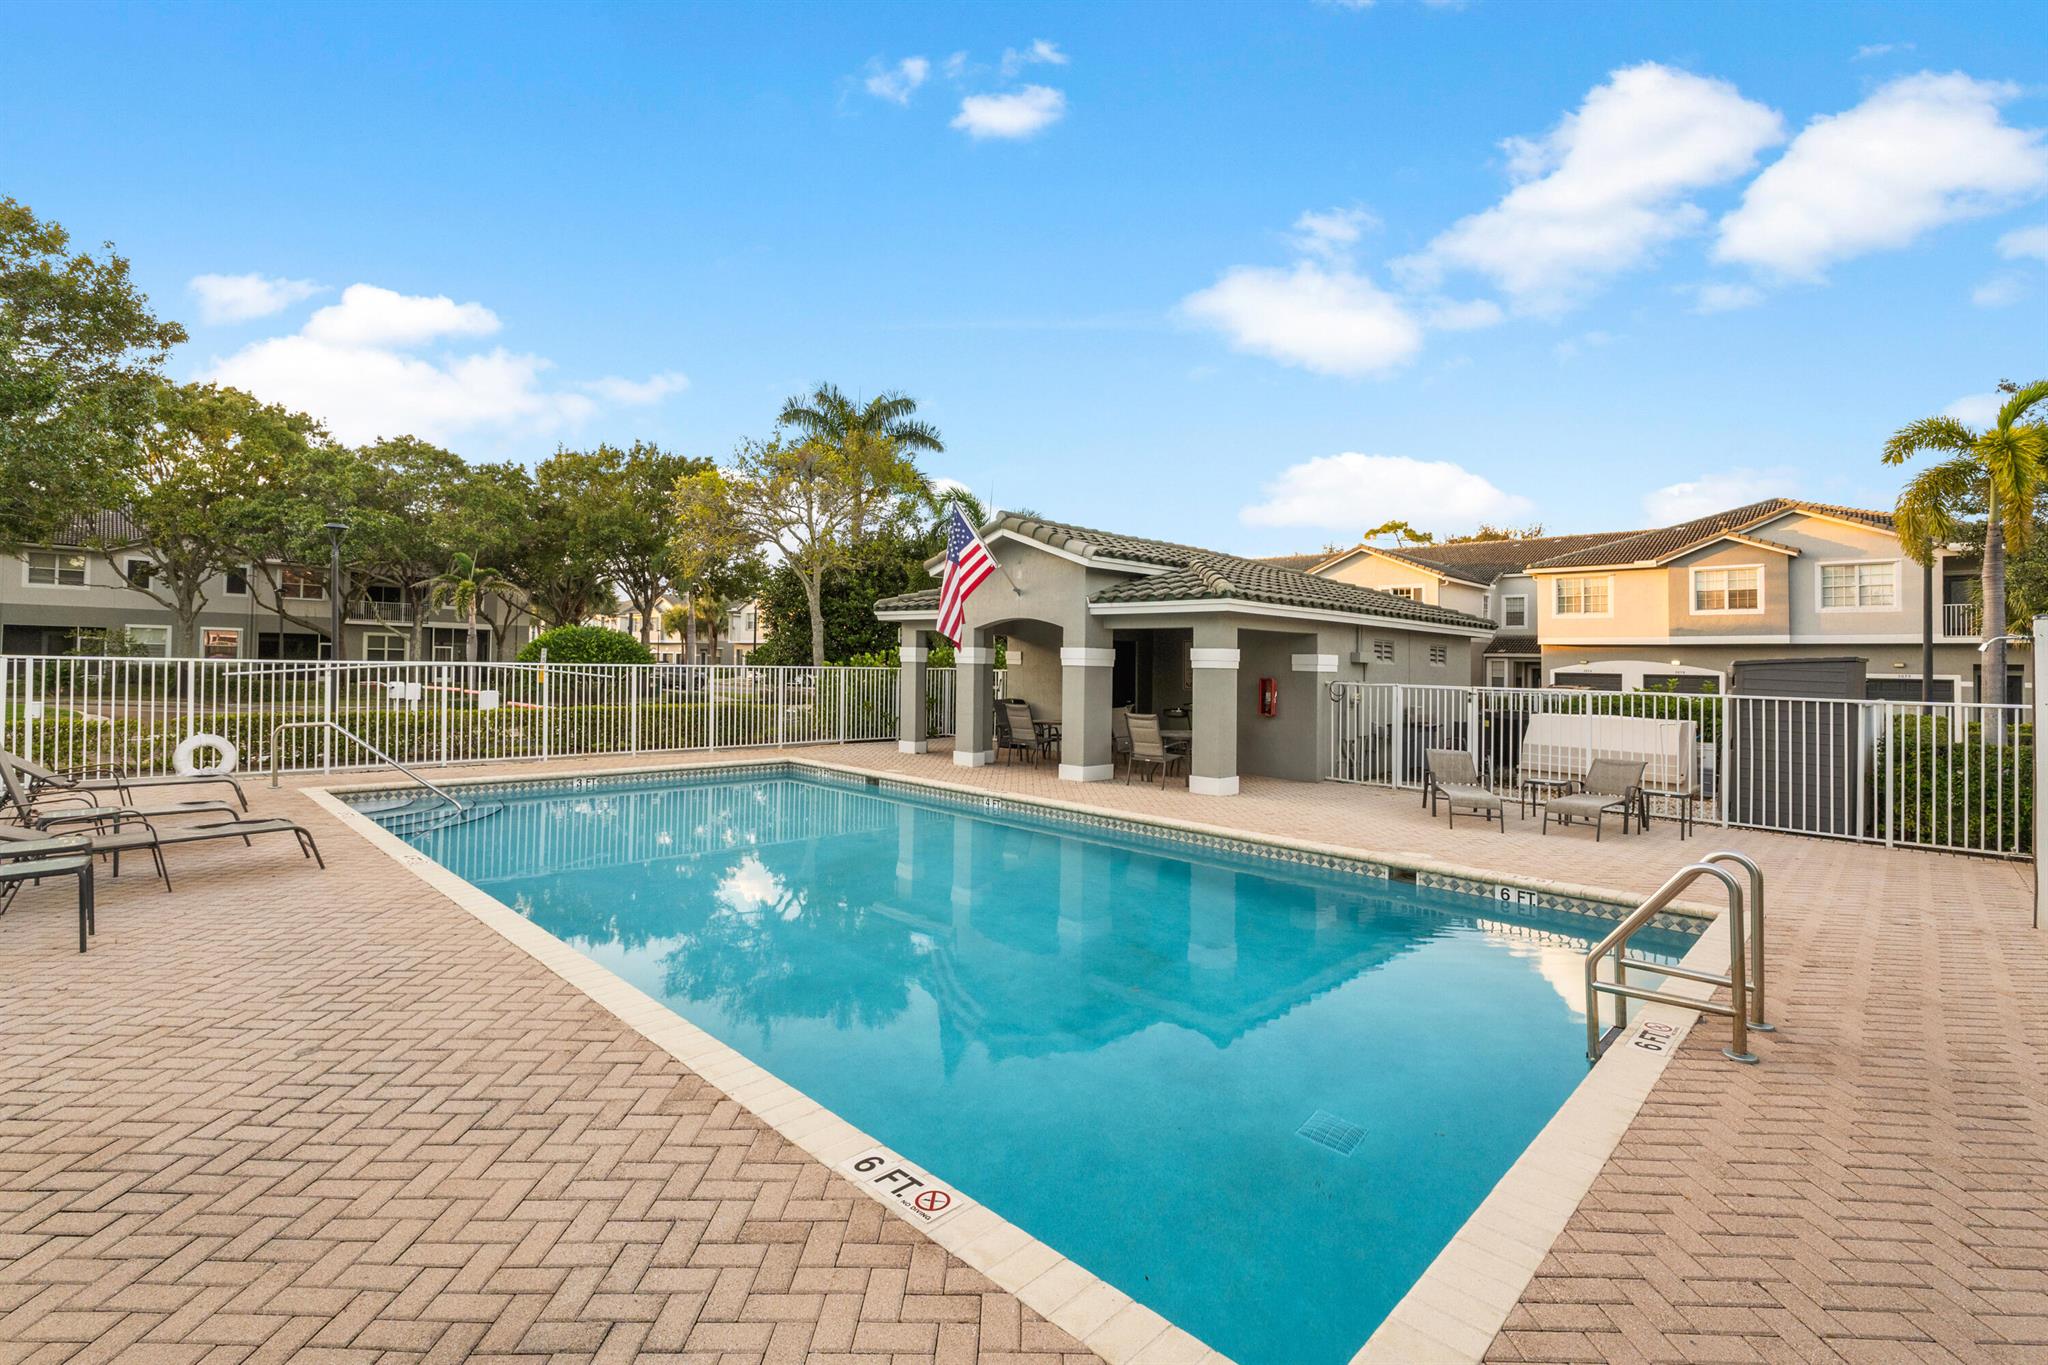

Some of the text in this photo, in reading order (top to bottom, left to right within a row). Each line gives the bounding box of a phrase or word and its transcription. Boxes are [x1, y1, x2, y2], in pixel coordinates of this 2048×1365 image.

[1500, 887, 1536, 907] 6 FT.
[1634, 1041, 1662, 1051] 6
[854, 1156, 925, 1198] 6 FT.
[901, 1199, 932, 1221] NO DIVING
